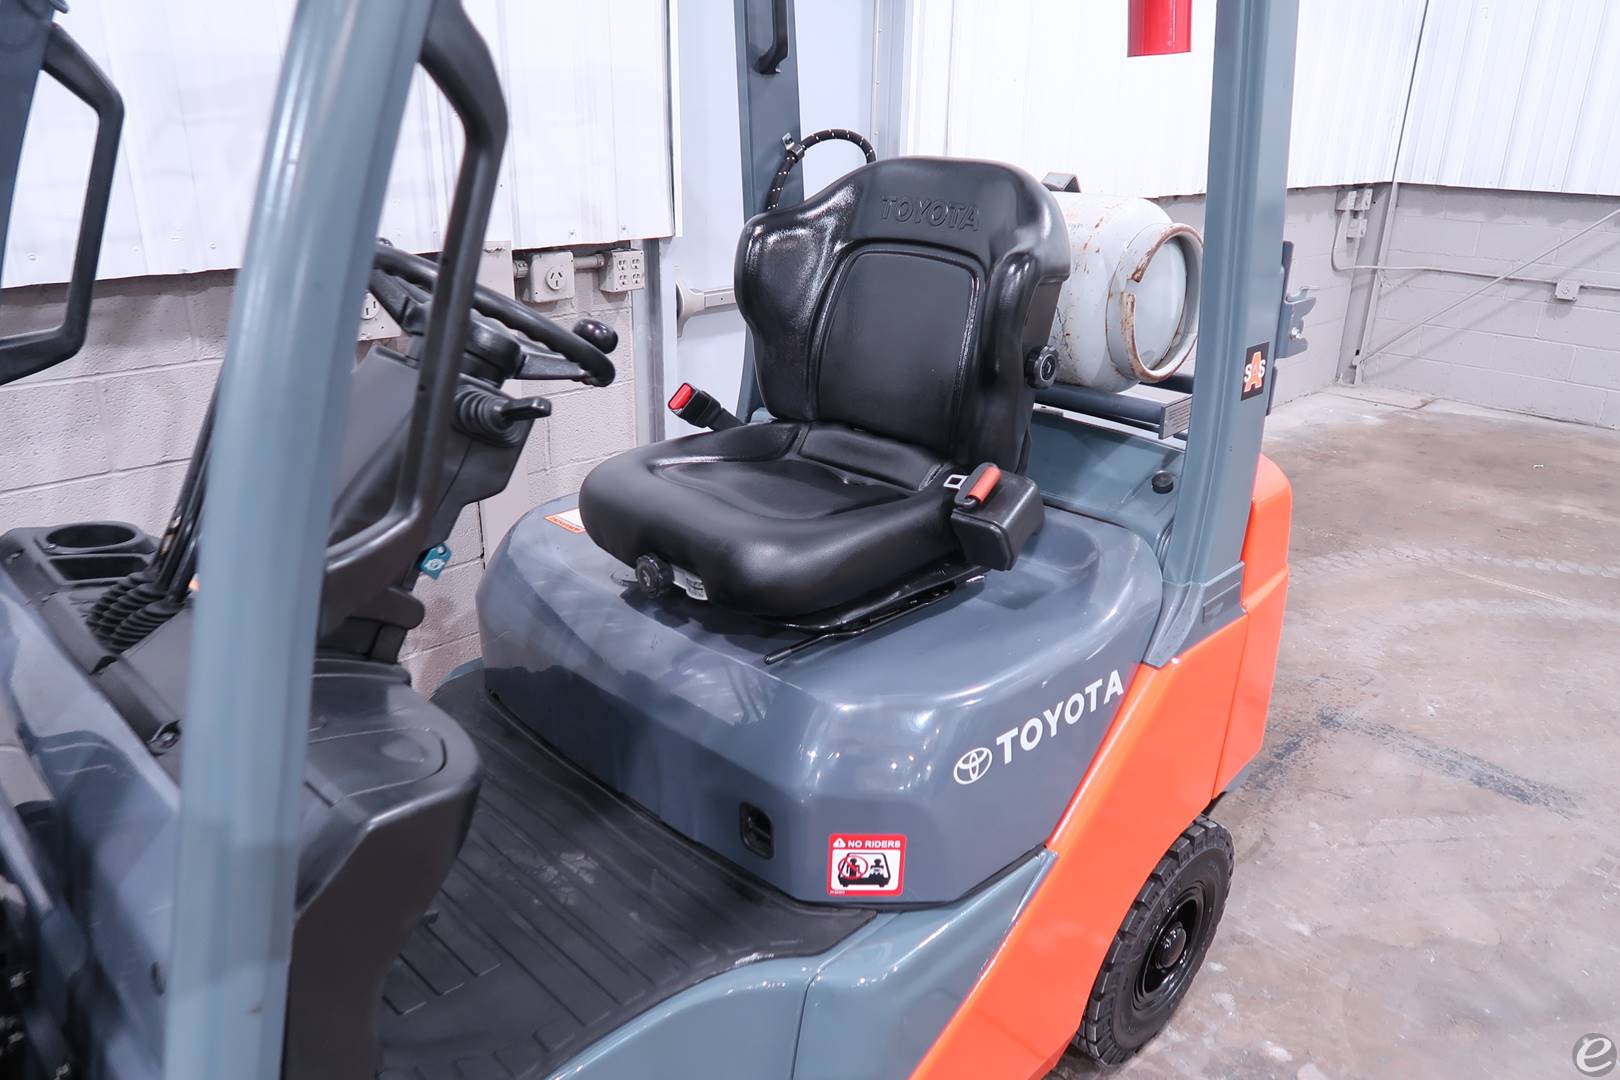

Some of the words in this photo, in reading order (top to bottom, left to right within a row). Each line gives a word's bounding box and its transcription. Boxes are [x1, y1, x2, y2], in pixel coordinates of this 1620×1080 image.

[881, 196, 979, 231] TOYOTA
[996, 669, 1124, 765] TOYOTA
[848, 840, 862, 848] NO
[865, 840, 901, 848] RIDERS
